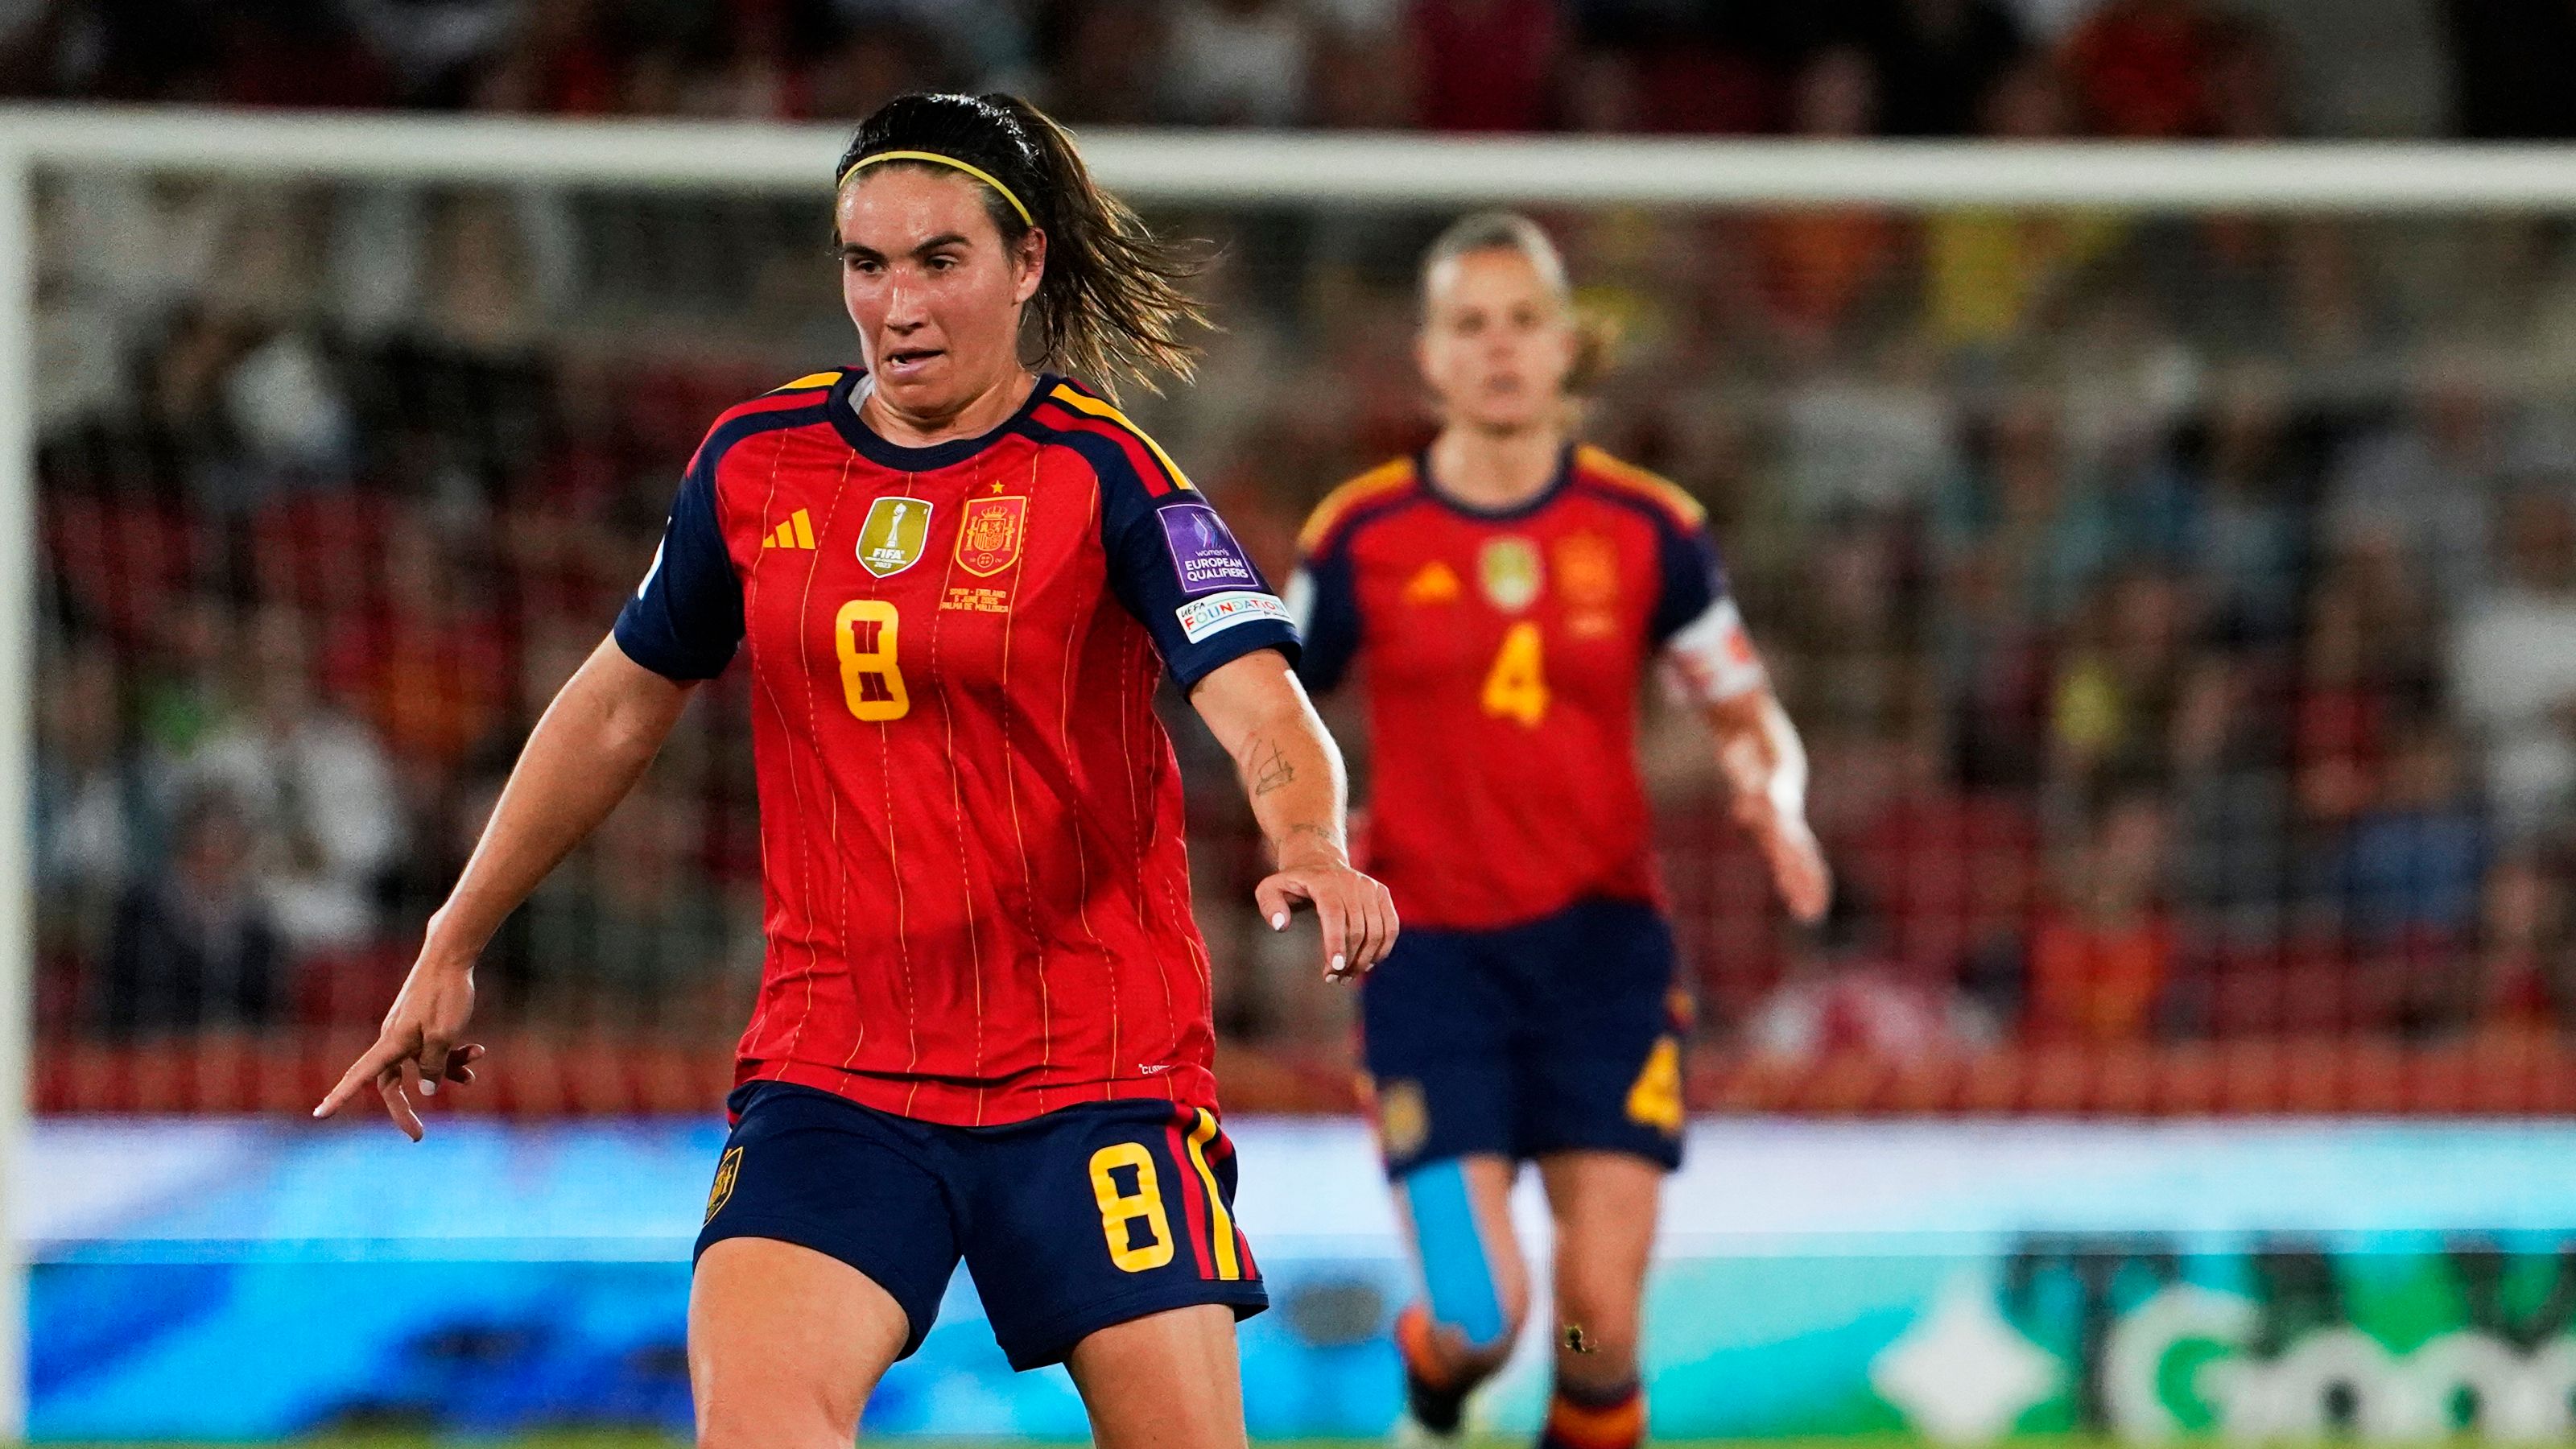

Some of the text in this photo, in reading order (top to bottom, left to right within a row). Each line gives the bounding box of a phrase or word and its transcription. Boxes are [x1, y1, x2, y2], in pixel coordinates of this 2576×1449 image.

[873, 547, 902, 560] FIFA
[1184, 557, 1245, 571] EUROPEAN
[1195, 548, 1230, 557] women's
[1187, 568, 1249, 582] QUALIFIERS
[1181, 602, 1206, 617] UEFA
[1184, 599, 1286, 630] FOUNDATION
[836, 600, 910, 722] 8
[1481, 621, 1551, 729] 4
[1624, 1034, 1686, 1139] 4
[1089, 1141, 1174, 1273] 8
[2103, 1286, 2576, 1441] Goo
